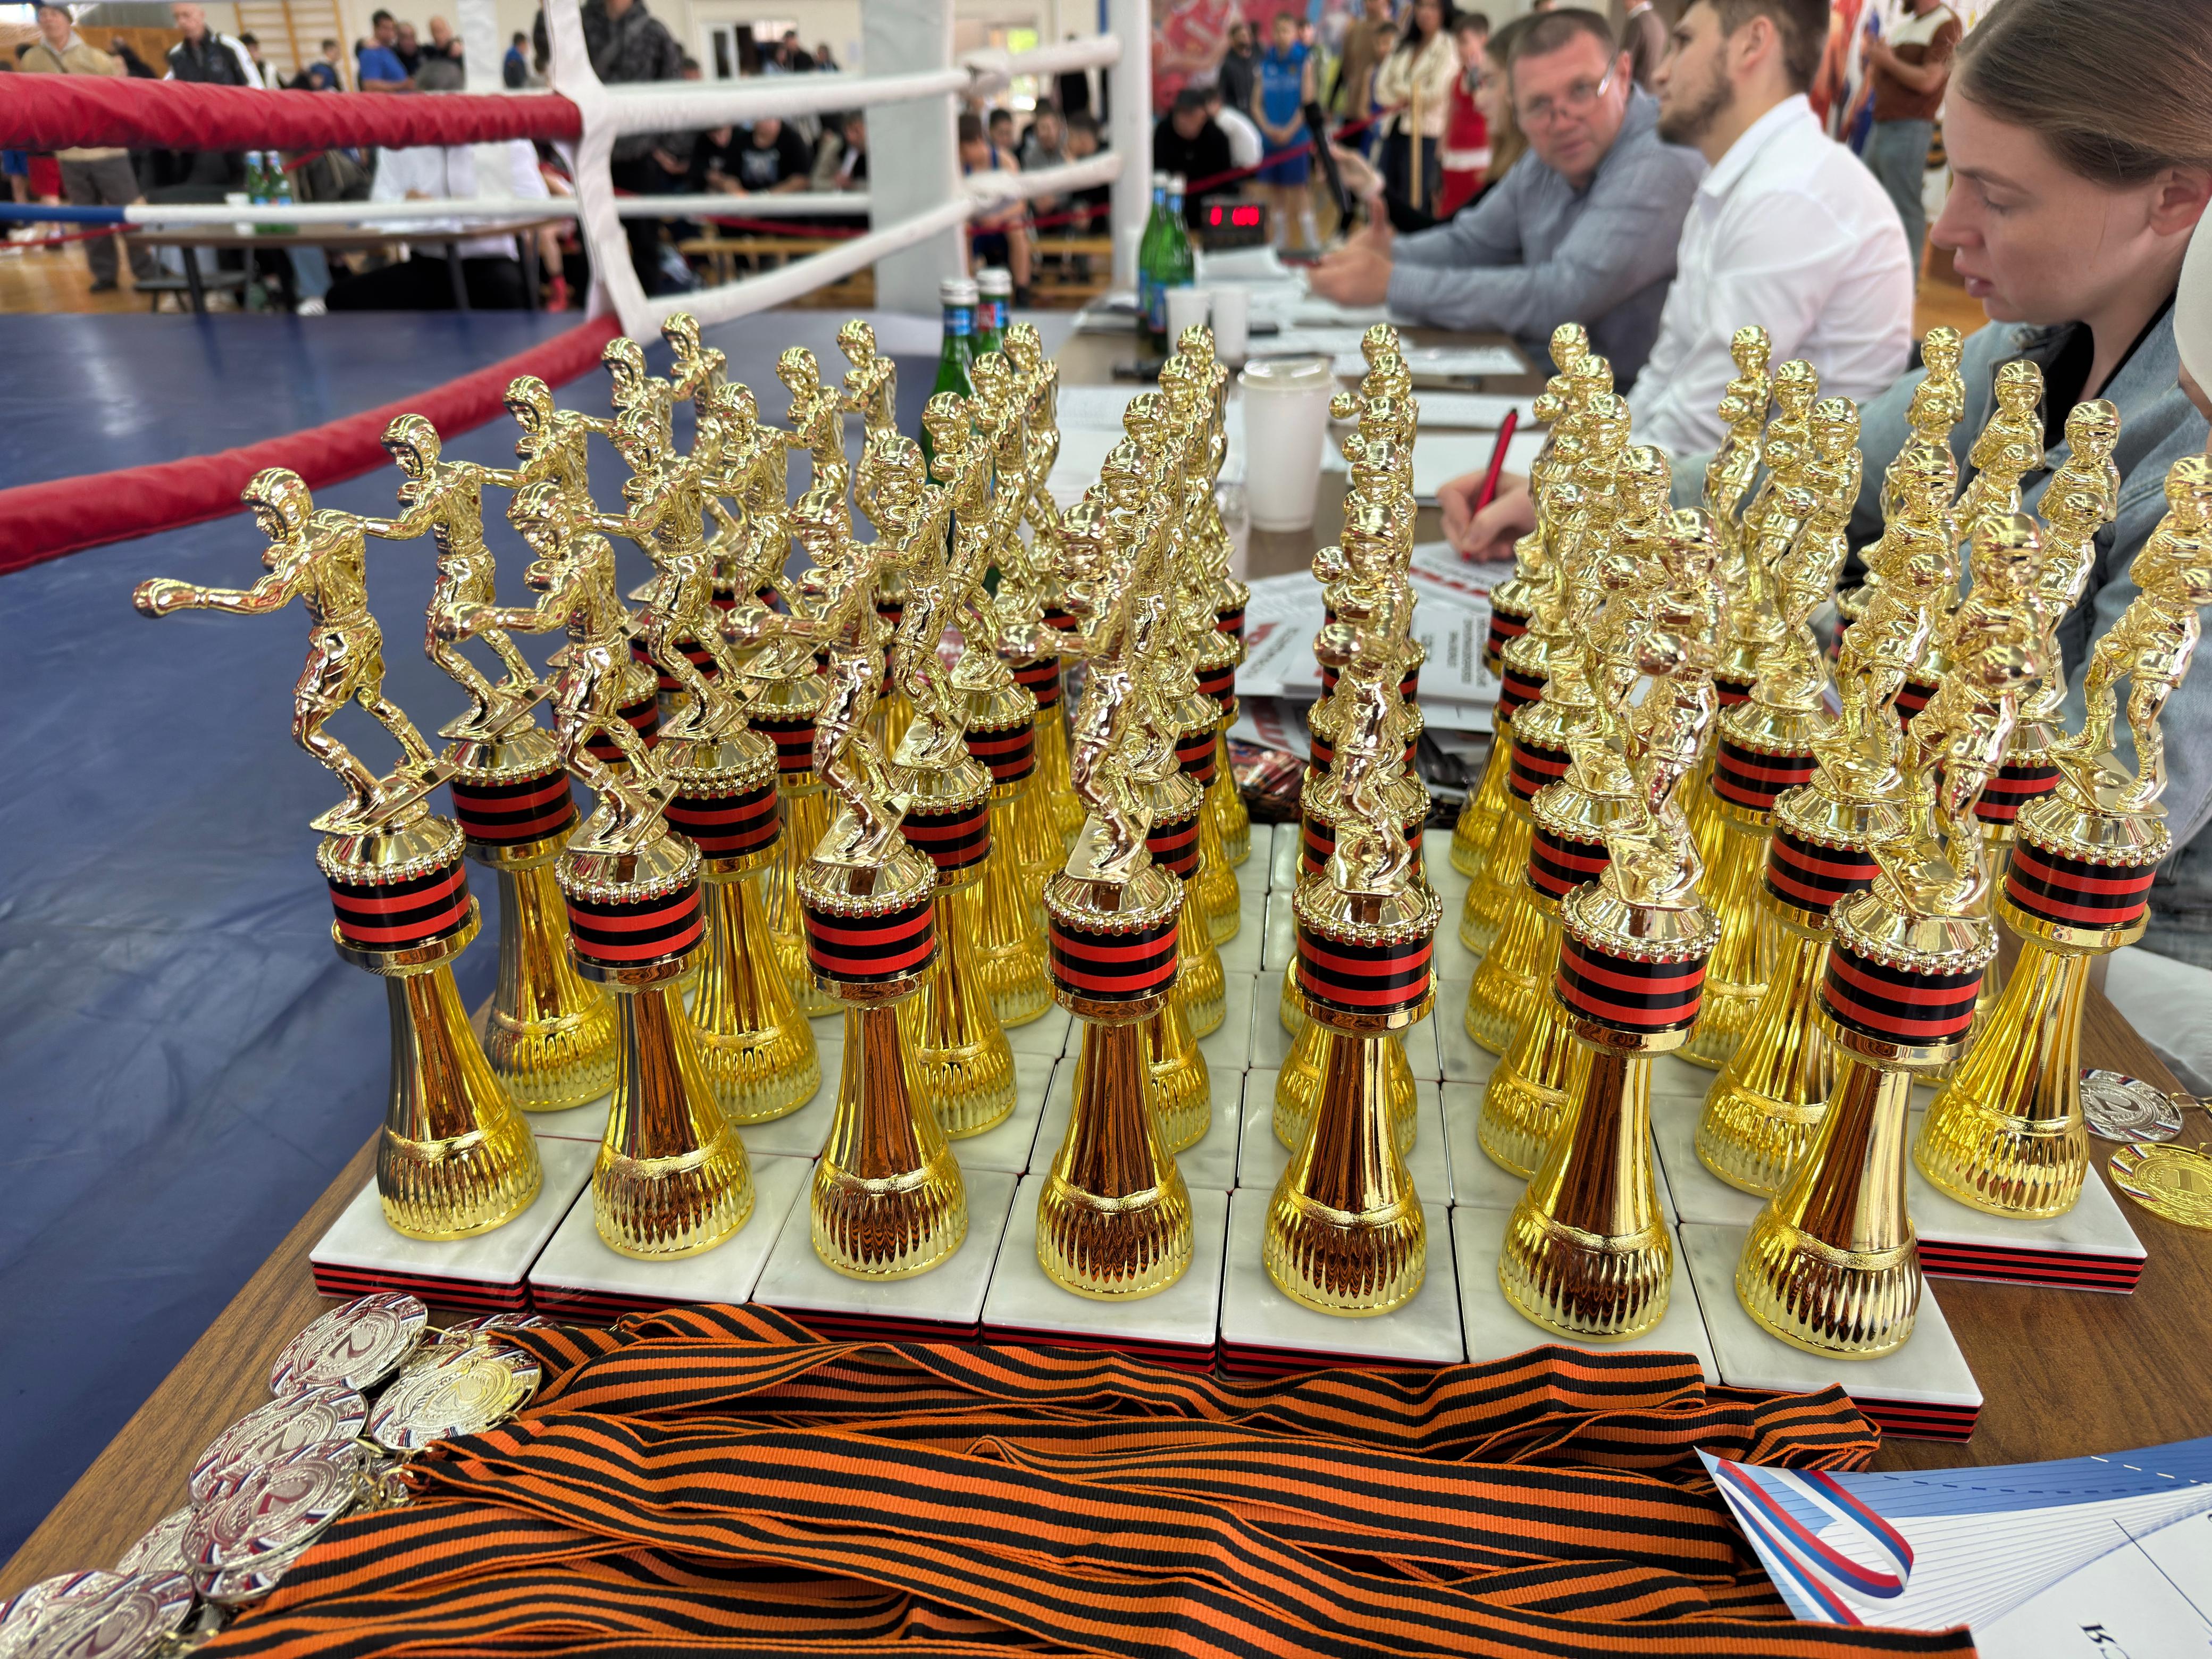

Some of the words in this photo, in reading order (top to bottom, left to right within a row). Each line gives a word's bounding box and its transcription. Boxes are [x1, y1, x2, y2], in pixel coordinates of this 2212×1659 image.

[2167, 1168, 2192, 1191] 1
[329, 1331, 375, 1359] 2
[258, 1479, 312, 1515] 2
